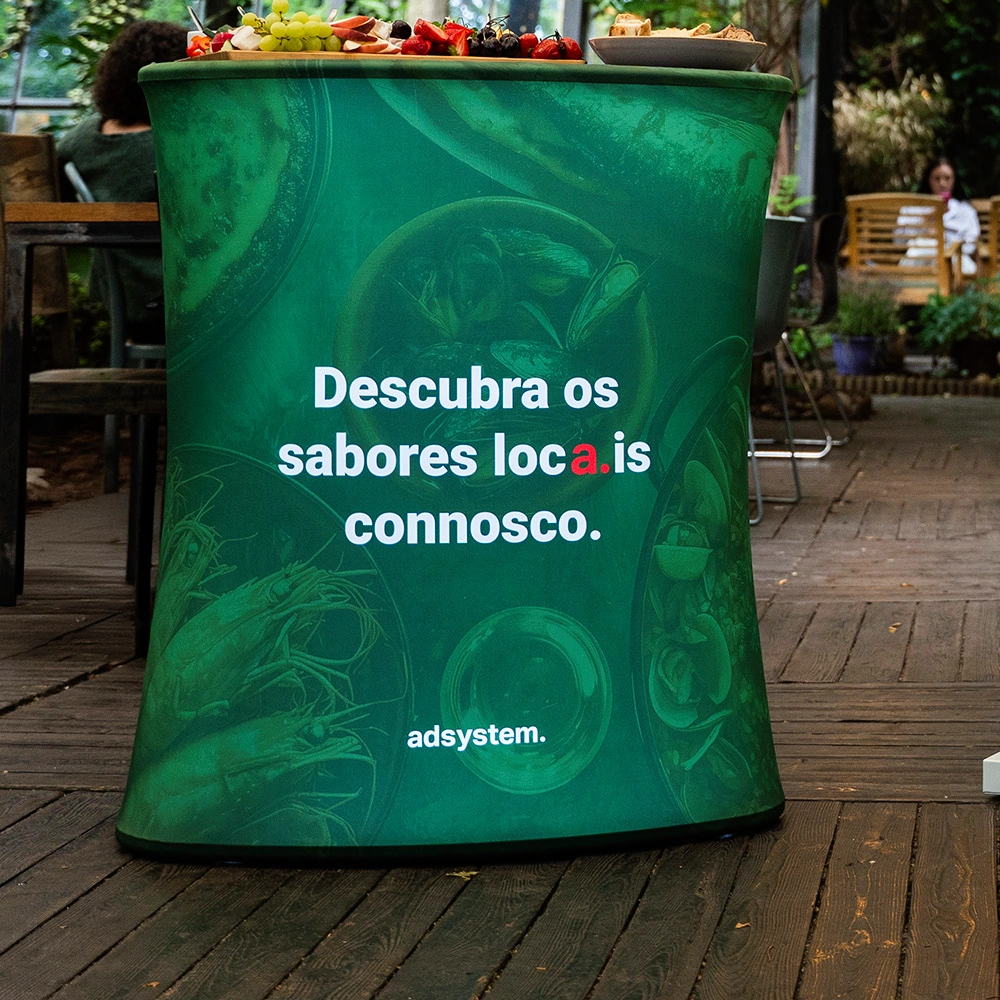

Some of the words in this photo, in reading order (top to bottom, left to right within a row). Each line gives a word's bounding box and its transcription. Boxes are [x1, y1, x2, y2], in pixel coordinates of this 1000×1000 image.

[314, 365, 549, 410] Descubra
[563, 376, 619, 409] os
[278, 432, 478, 477] sabores
[344, 509, 601, 545] connosco.
[407, 724, 546, 752] adsystem.
